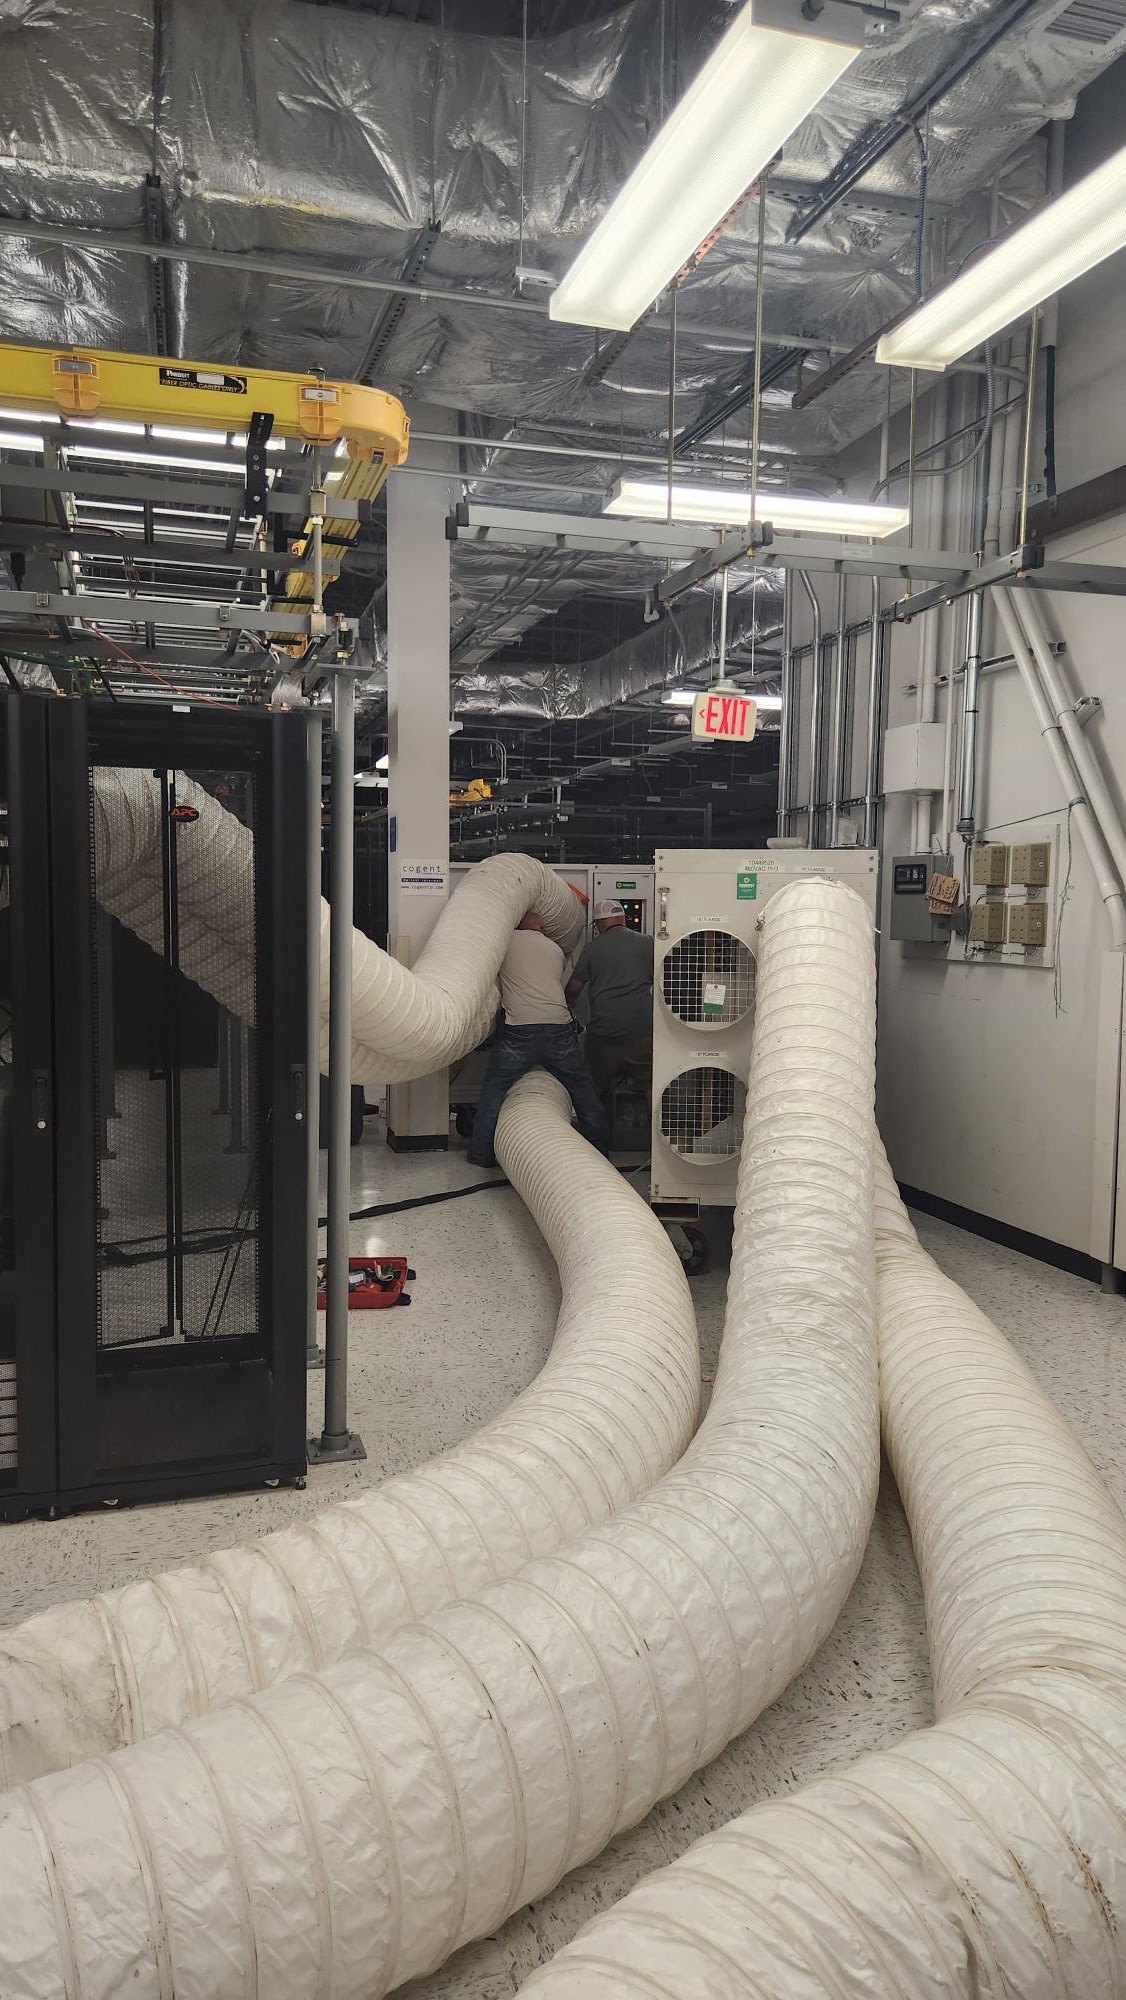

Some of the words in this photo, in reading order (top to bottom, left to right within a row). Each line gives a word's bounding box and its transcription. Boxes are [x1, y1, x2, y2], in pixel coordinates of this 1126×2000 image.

[166, 369, 190, 378] PANDUIT
[706, 697, 750, 736] EXIT
[171, 808, 197, 817] APC
[402, 866, 441, 874] cogent
